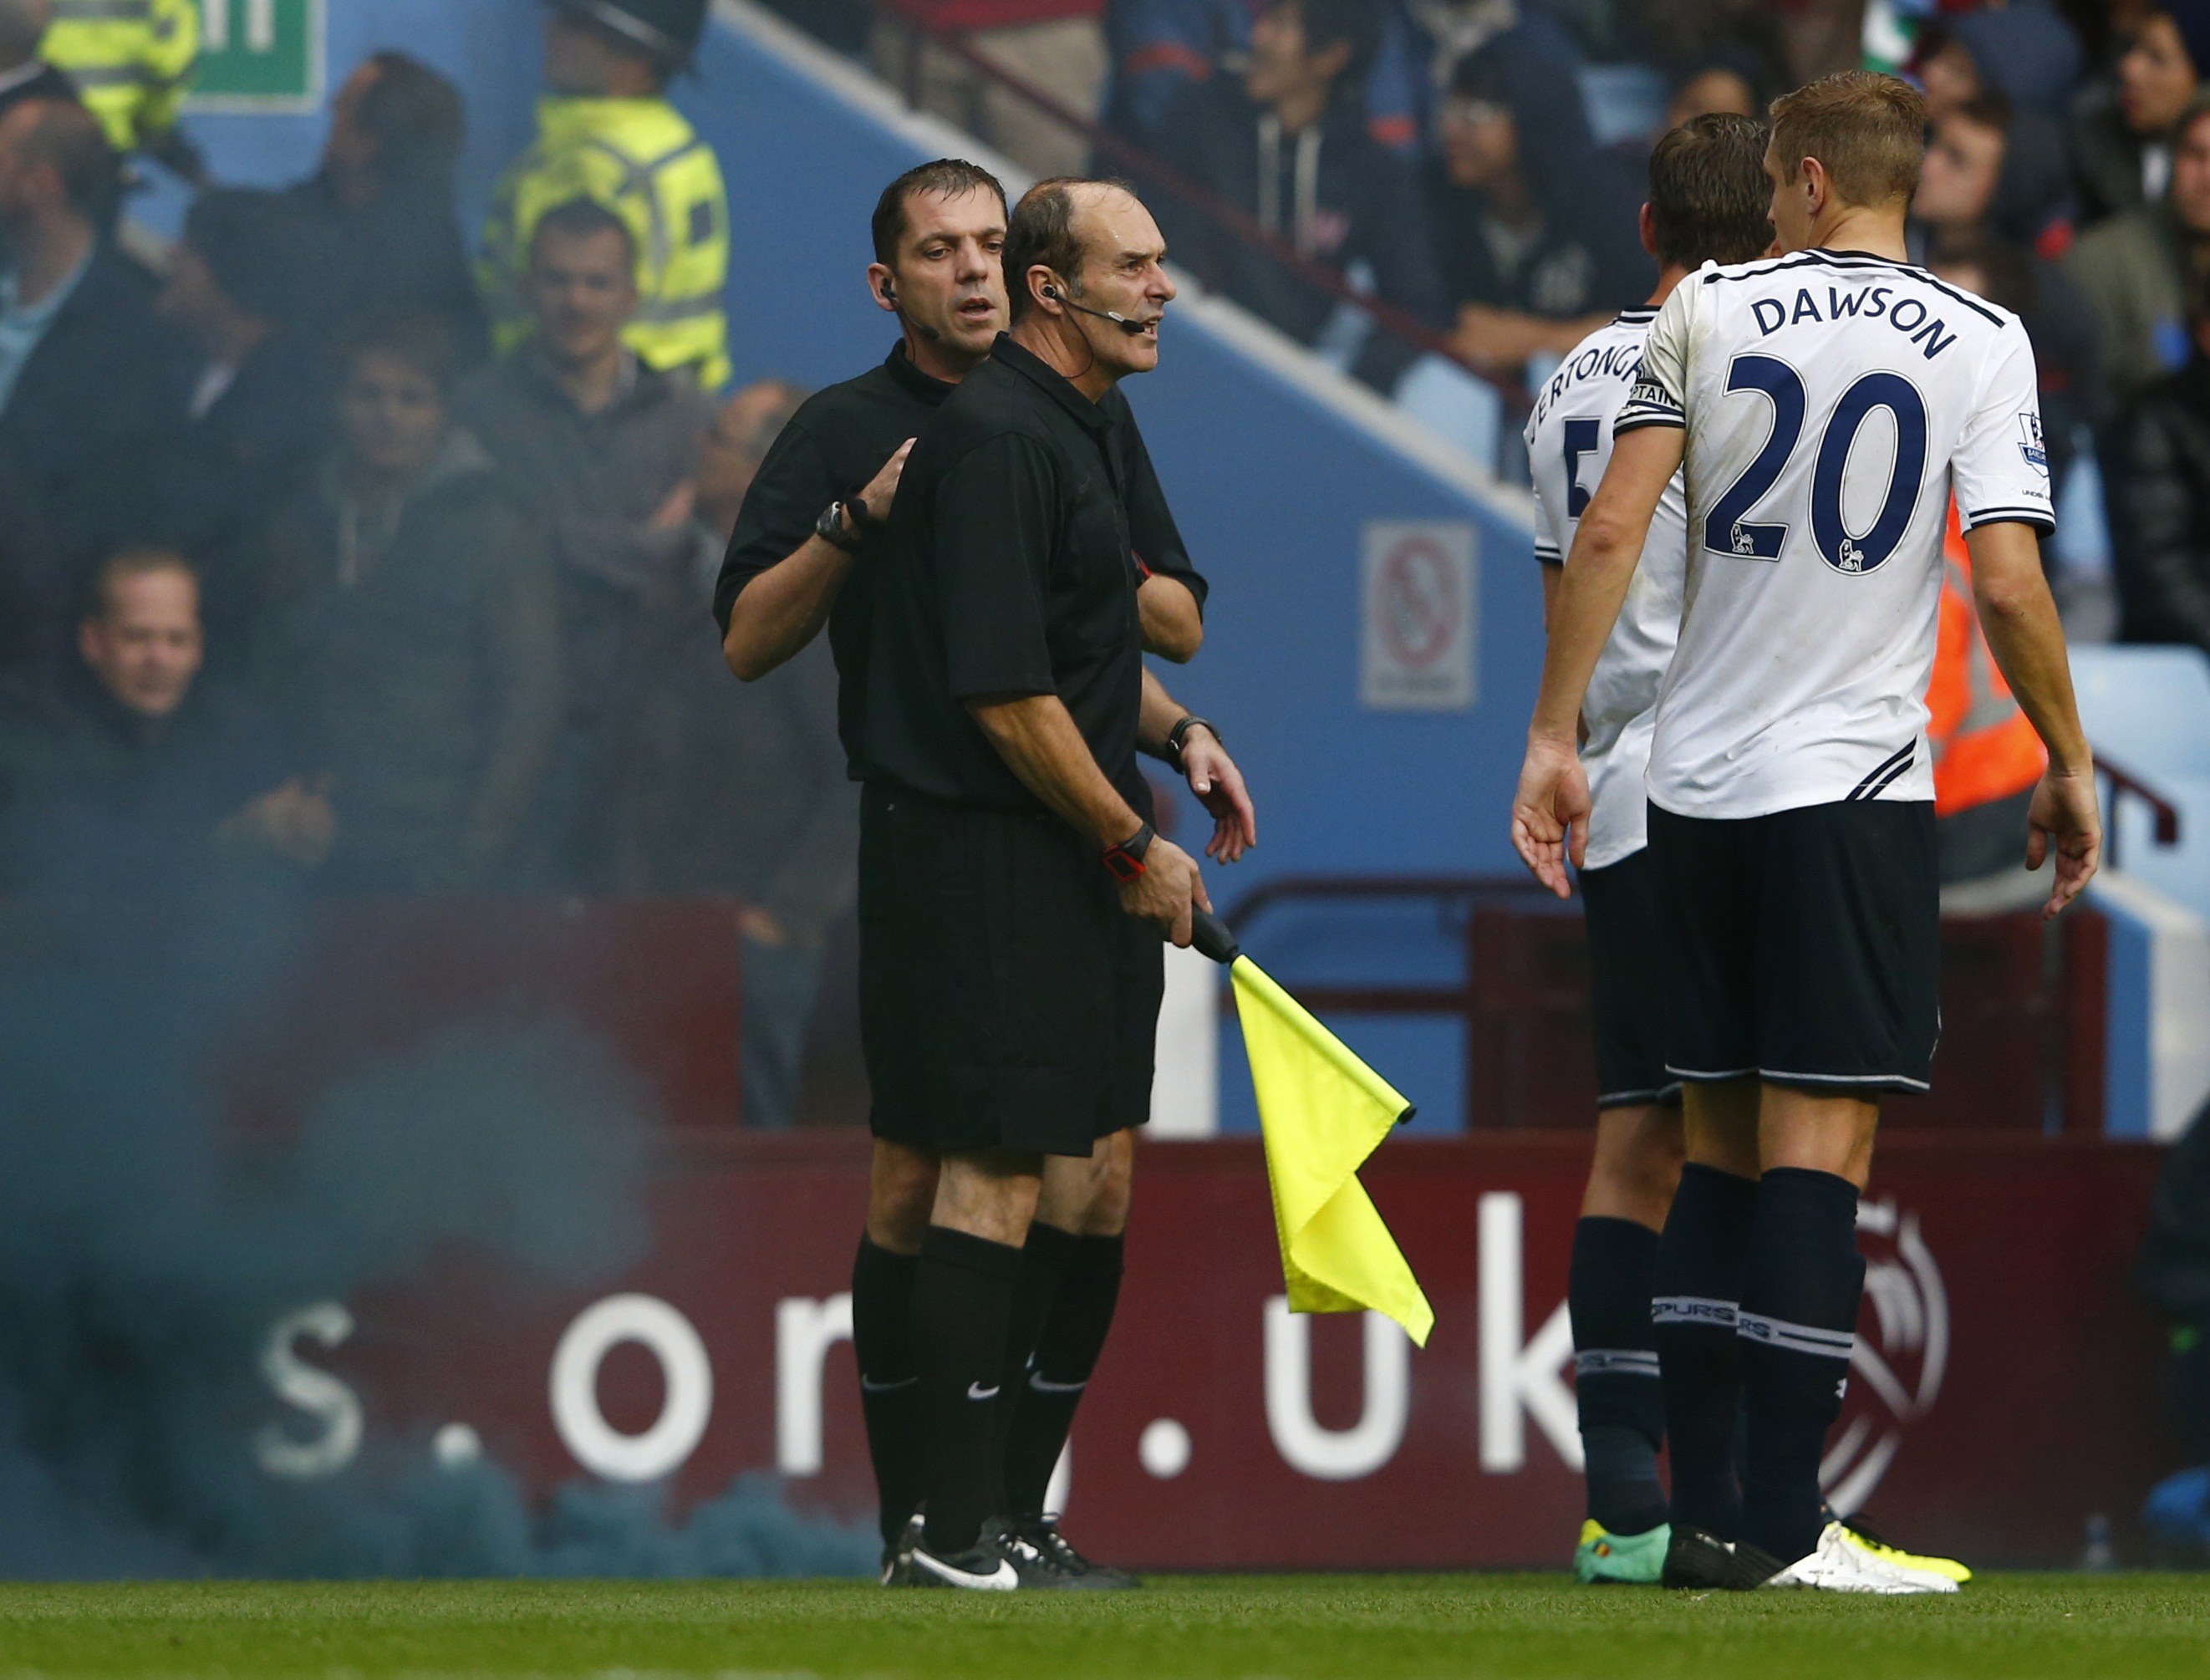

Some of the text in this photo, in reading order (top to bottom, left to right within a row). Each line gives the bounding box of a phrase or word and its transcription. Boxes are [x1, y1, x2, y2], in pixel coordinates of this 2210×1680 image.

[1749, 286, 1958, 360] DAWSON
[1629, 384, 1677, 407] PTAIN
[1703, 352, 1931, 576] 20
